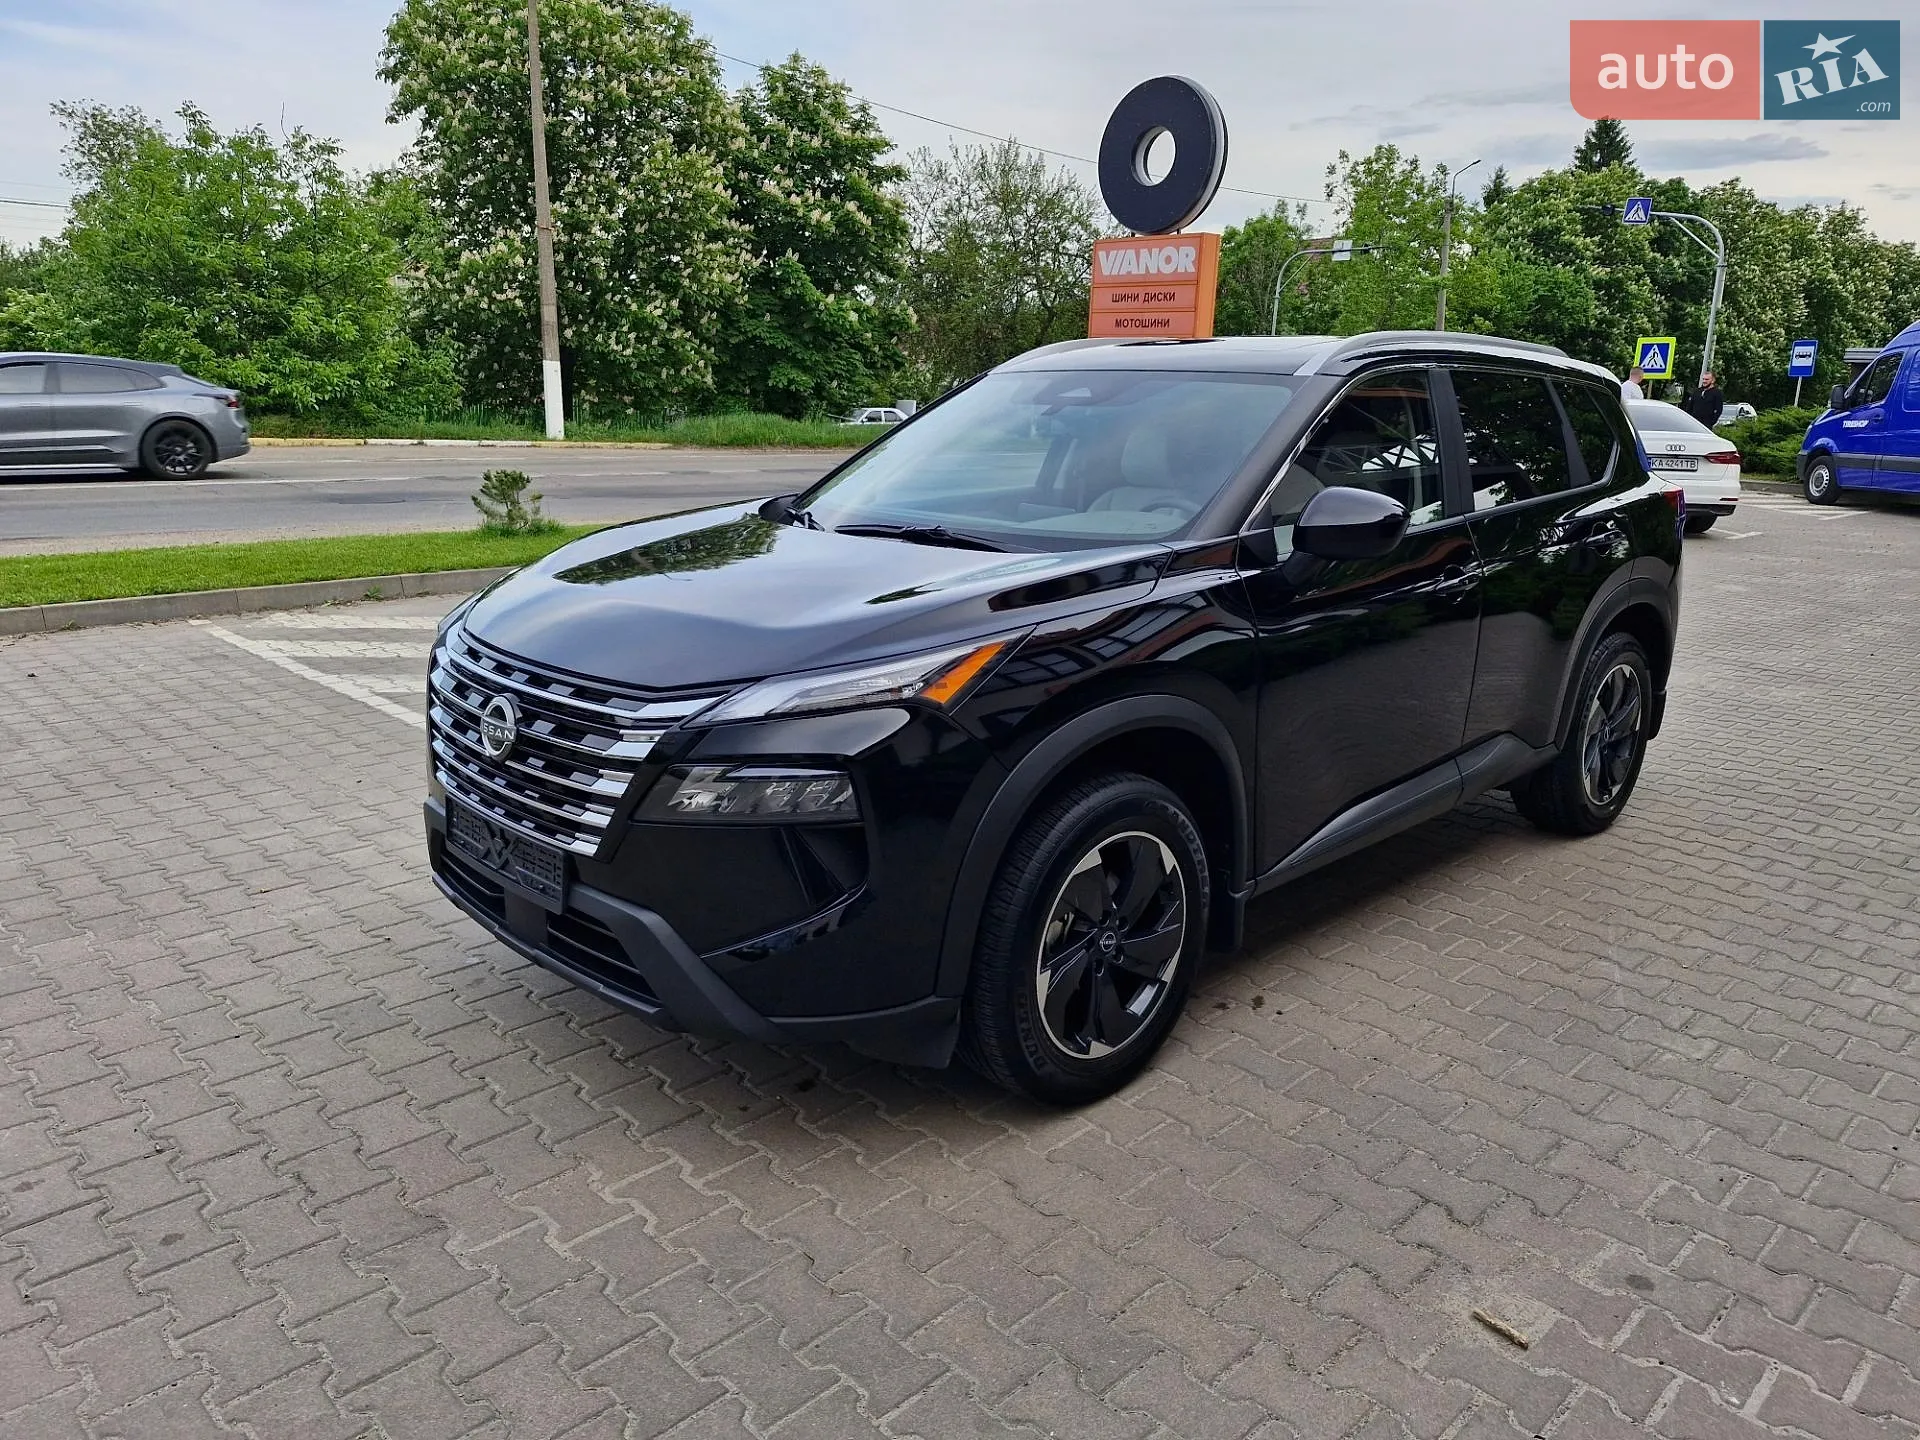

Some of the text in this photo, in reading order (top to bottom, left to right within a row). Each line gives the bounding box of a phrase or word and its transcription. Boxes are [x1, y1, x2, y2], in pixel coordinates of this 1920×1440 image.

[1098, 246, 1196, 275] VIANOR
[1112, 292, 1176, 304] ШИНИ ДИСКИ
[1114, 318, 1170, 329] МОТОШИНИ
[483, 722, 515, 739] SSAN
